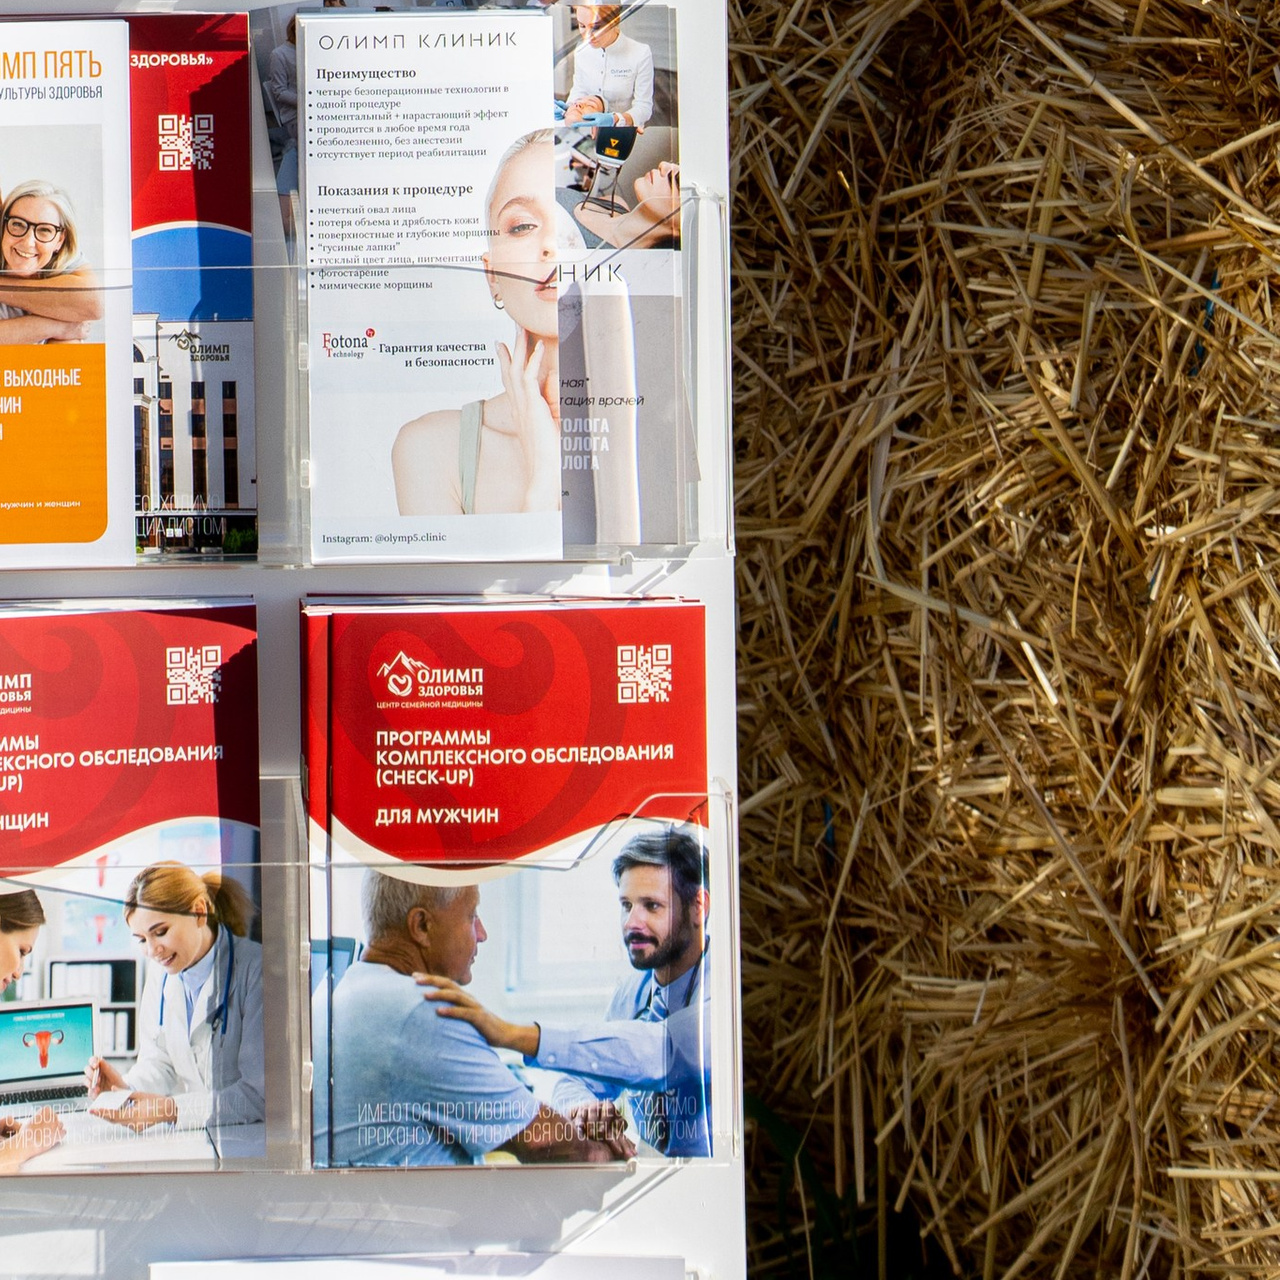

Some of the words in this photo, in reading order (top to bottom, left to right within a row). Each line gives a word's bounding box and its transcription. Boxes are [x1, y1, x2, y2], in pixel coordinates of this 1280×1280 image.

[319, 35, 404, 51] ОЛИМП
[418, 32, 518, 48] КЛИНИК
[130, 54, 213, 68] ЗДОРОВЬЯ»
[316, 68, 416, 81] Преимущество
[318, 185, 389, 197] Показания
[392, 187, 399, 195] к
[402, 184, 473, 198] процедуре
[189, 344, 230, 354] ОЛИМП
[379, 342, 433, 353] Гарантия
[436, 342, 486, 353] качества
[190, 354, 230, 362] ЗДОРОВЬЯ
[405, 358, 413, 366] и
[415, 356, 494, 367] безопасности
[4, 367, 82, 390] ВЫХОДНЫЕ
[322, 534, 373, 545] Instagram:
[375, 531, 447, 544] @olymp5.clinic
[376, 730, 491, 746] ПРОГРАММЫ
[79, 746, 223, 767] ОБСЛЕДОВАНИЯ
[376, 748, 526, 765] КОМПЛЕКСНОГО
[531, 744, 674, 764] ОБСЛЕДОВАНИЯ
[376, 769, 474, 787] (CHECK-UP)
[375, 809, 411, 826] ДЛЯ
[417, 808, 499, 824] МУЖЧИН
